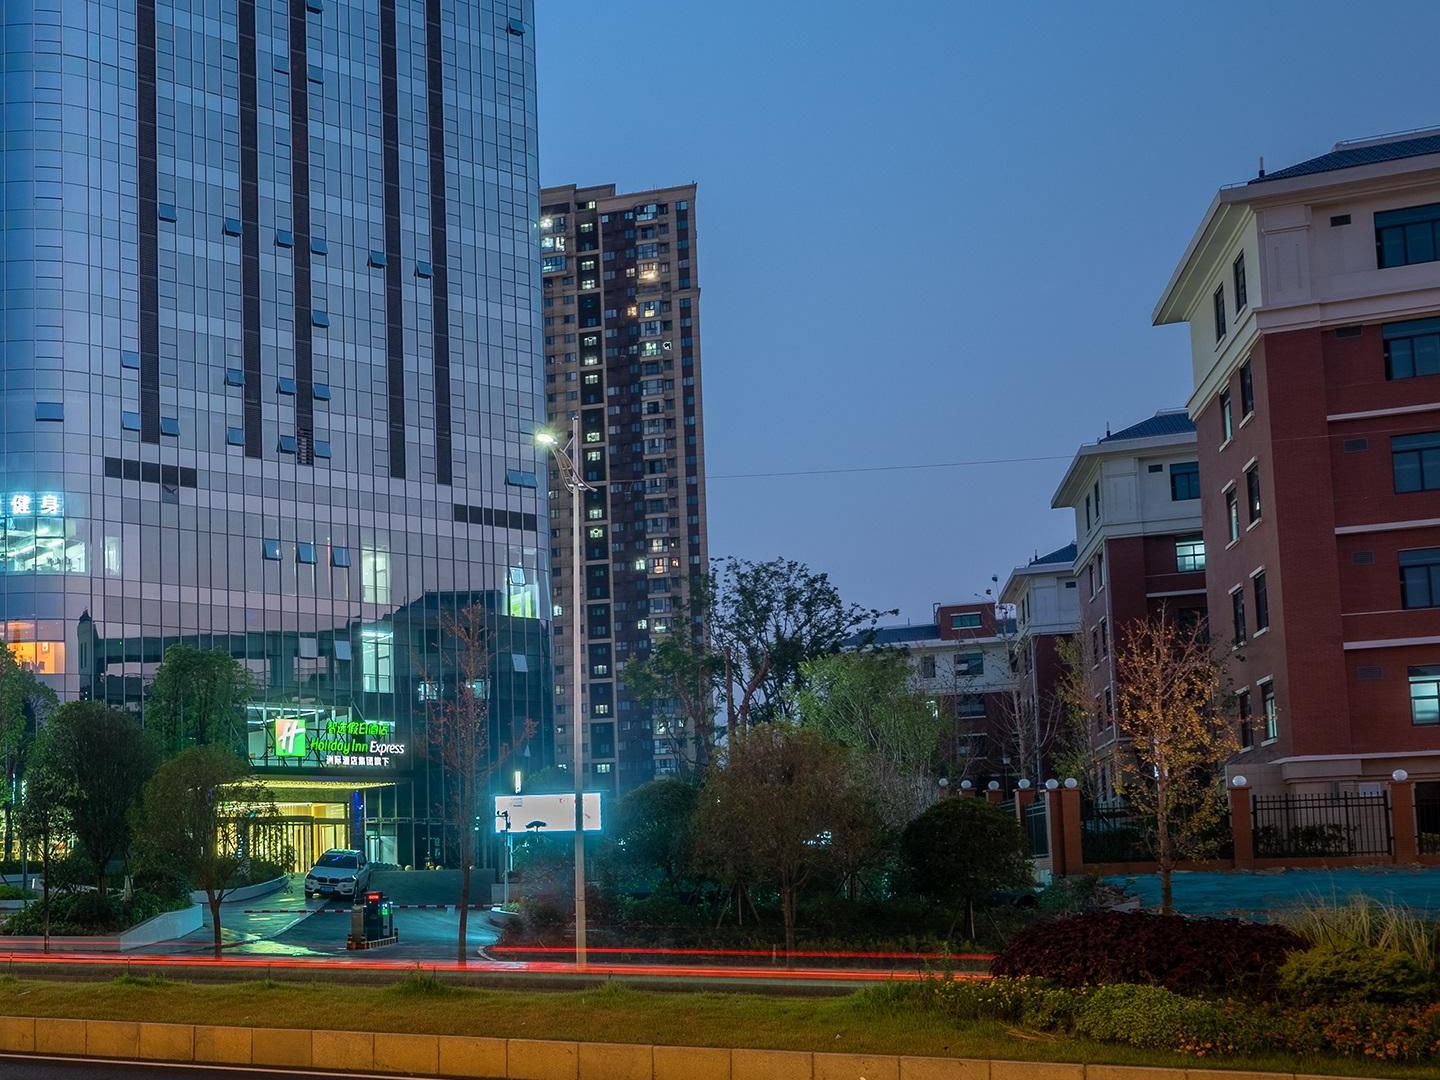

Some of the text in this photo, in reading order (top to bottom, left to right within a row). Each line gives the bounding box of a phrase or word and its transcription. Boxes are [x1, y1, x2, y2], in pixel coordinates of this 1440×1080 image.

[326, 721, 389, 736] 智选假日酒店
[310, 738, 406, 755] Holiday Inn Express
